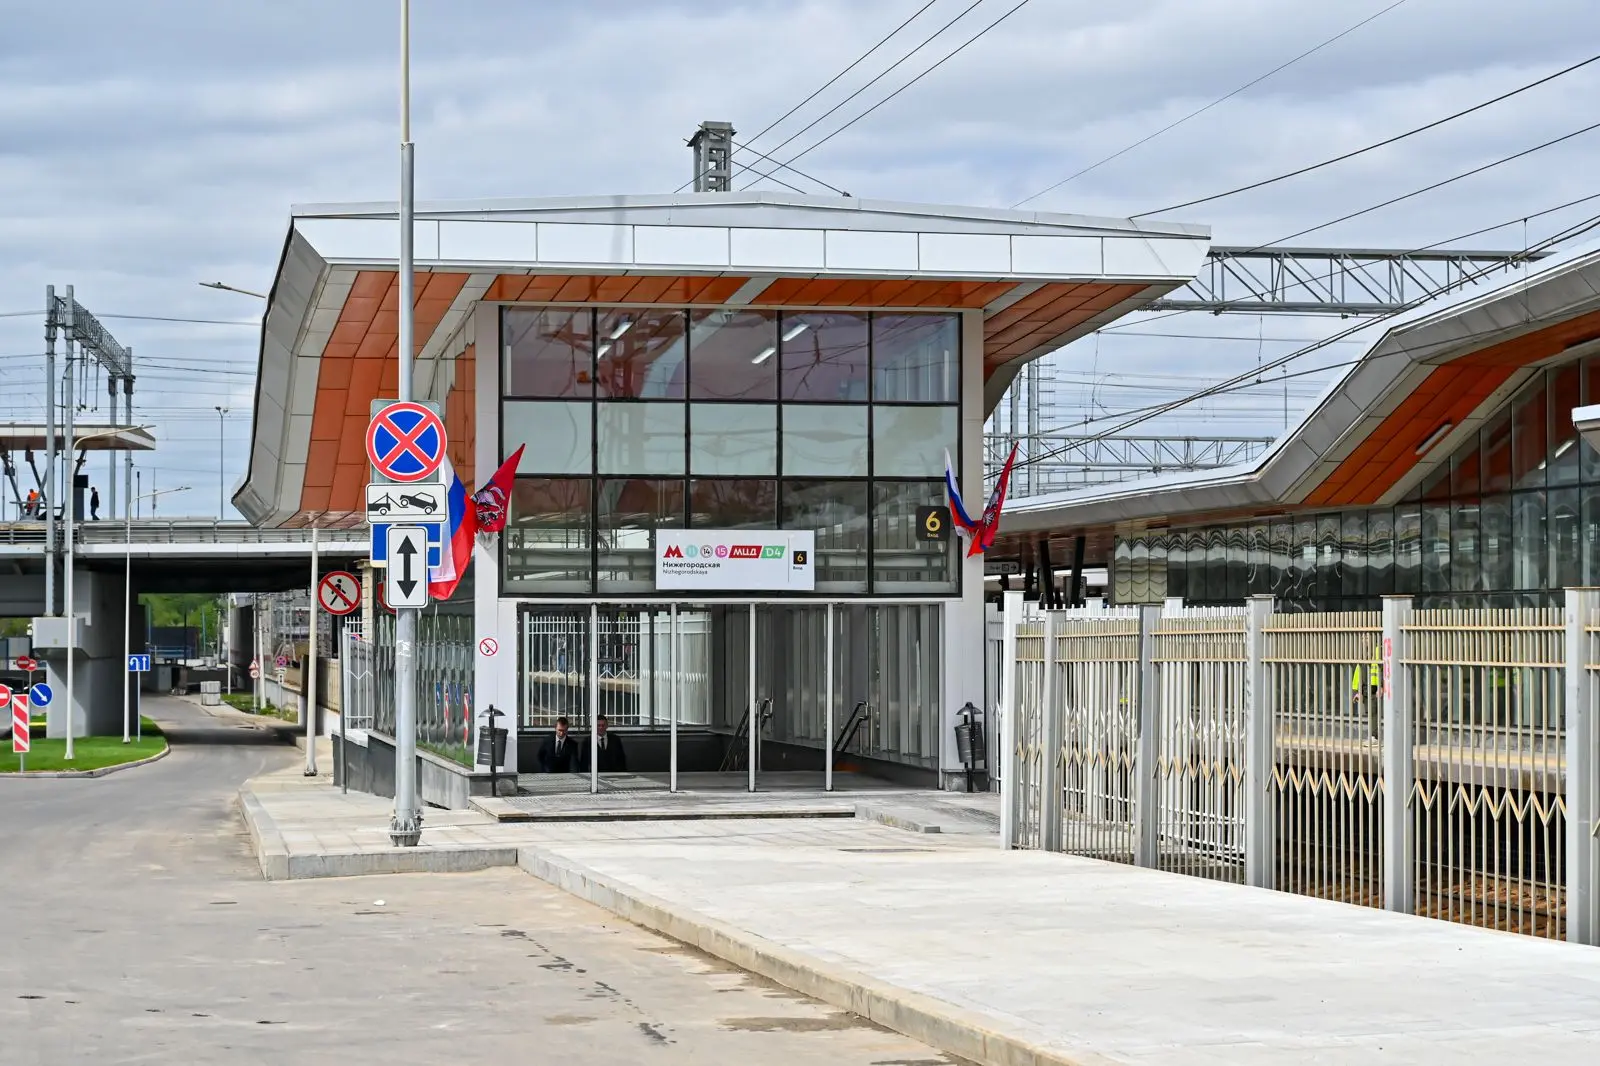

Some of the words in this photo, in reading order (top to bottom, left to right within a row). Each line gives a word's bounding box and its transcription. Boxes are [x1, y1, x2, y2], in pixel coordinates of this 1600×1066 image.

[926, 511, 941, 531] 6
[717, 547, 726, 555] 15
[733, 547, 757, 556] МЦД
[765, 547, 781, 557] D4
[796, 553, 804, 562] 6
[662, 561, 721, 569] Нижегородская
